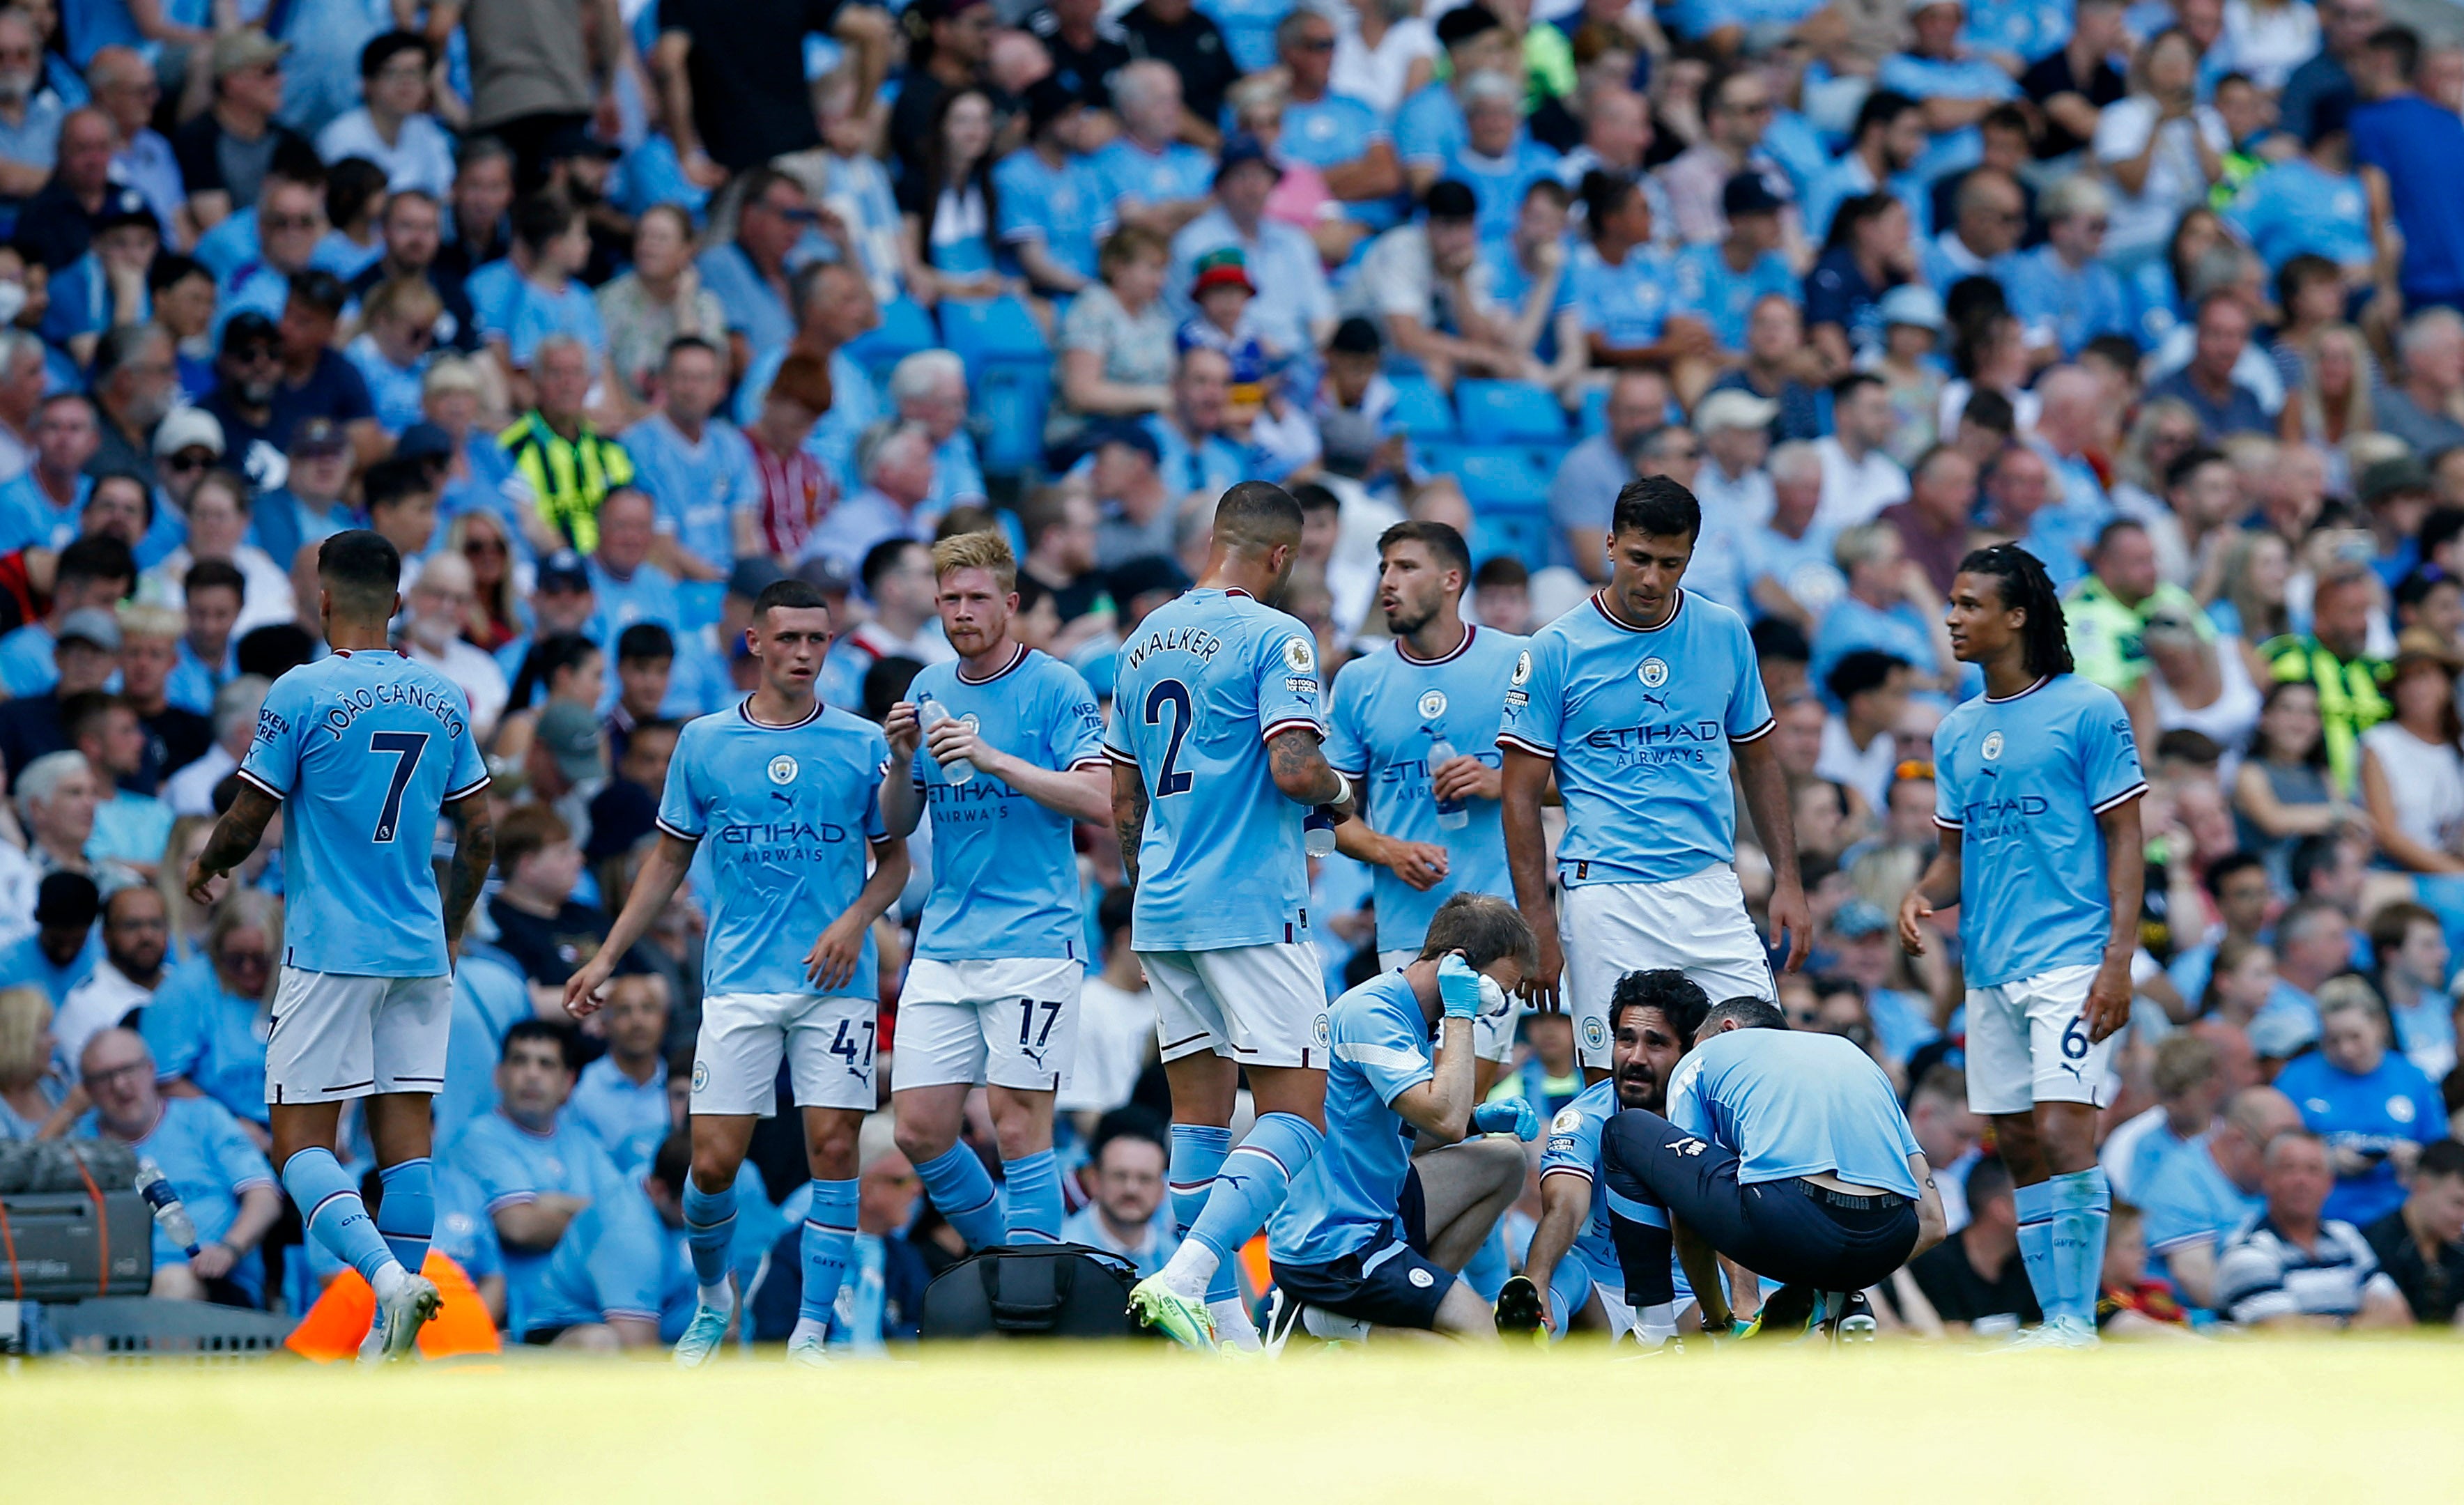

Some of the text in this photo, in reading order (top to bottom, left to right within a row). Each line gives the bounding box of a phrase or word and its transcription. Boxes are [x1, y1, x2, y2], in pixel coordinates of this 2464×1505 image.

[1127, 626, 1222, 671] WALKER
[261, 709, 290, 734] EXEN
[321, 684, 464, 741] JOÃO CANCELO
[1586, 720, 1719, 748] ETIHAD
[1144, 677, 1194, 799] 2
[1616, 749, 1704, 766] AIRWAYS
[369, 730, 430, 843] 7
[1381, 752, 1503, 783] ETID
[722, 821, 846, 844] ETIHAD
[830, 1019, 875, 1067] 47
[1019, 998, 1063, 1047] 17
[2061, 1014, 2088, 1059] 6
[1826, 1190, 1870, 1210] PUMA
